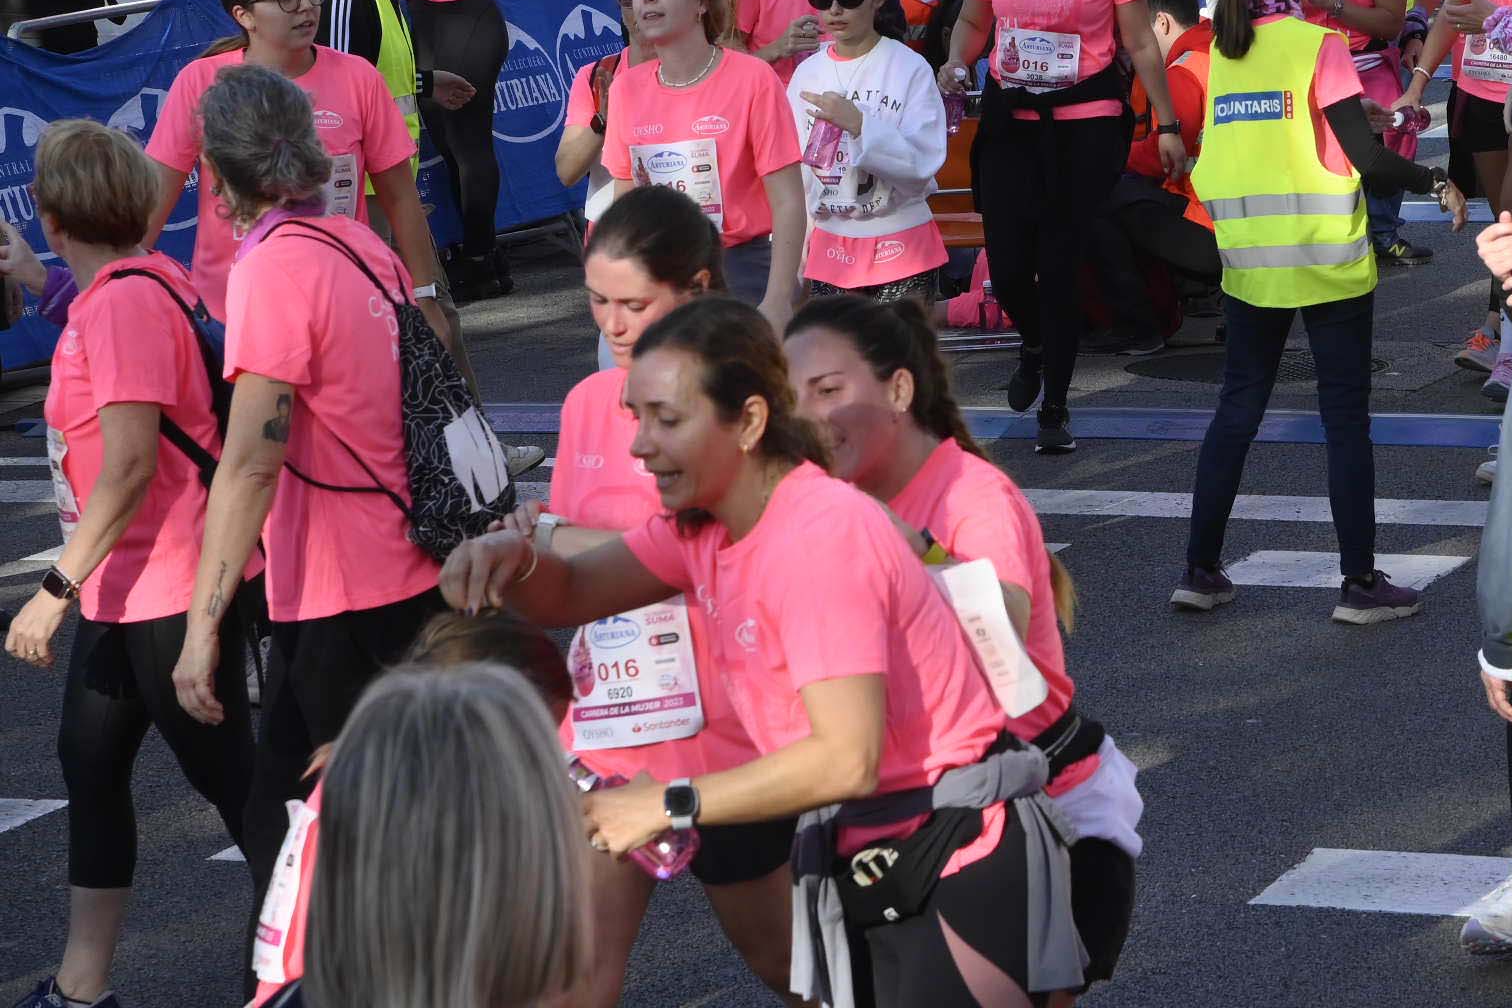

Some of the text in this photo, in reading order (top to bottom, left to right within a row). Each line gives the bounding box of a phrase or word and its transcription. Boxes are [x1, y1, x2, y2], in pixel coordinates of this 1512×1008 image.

[1022, 59, 1049, 72] 016
[597, 658, 640, 682] 016
[607, 686, 633, 699] 6920
[641, 716, 691, 733] Santander
